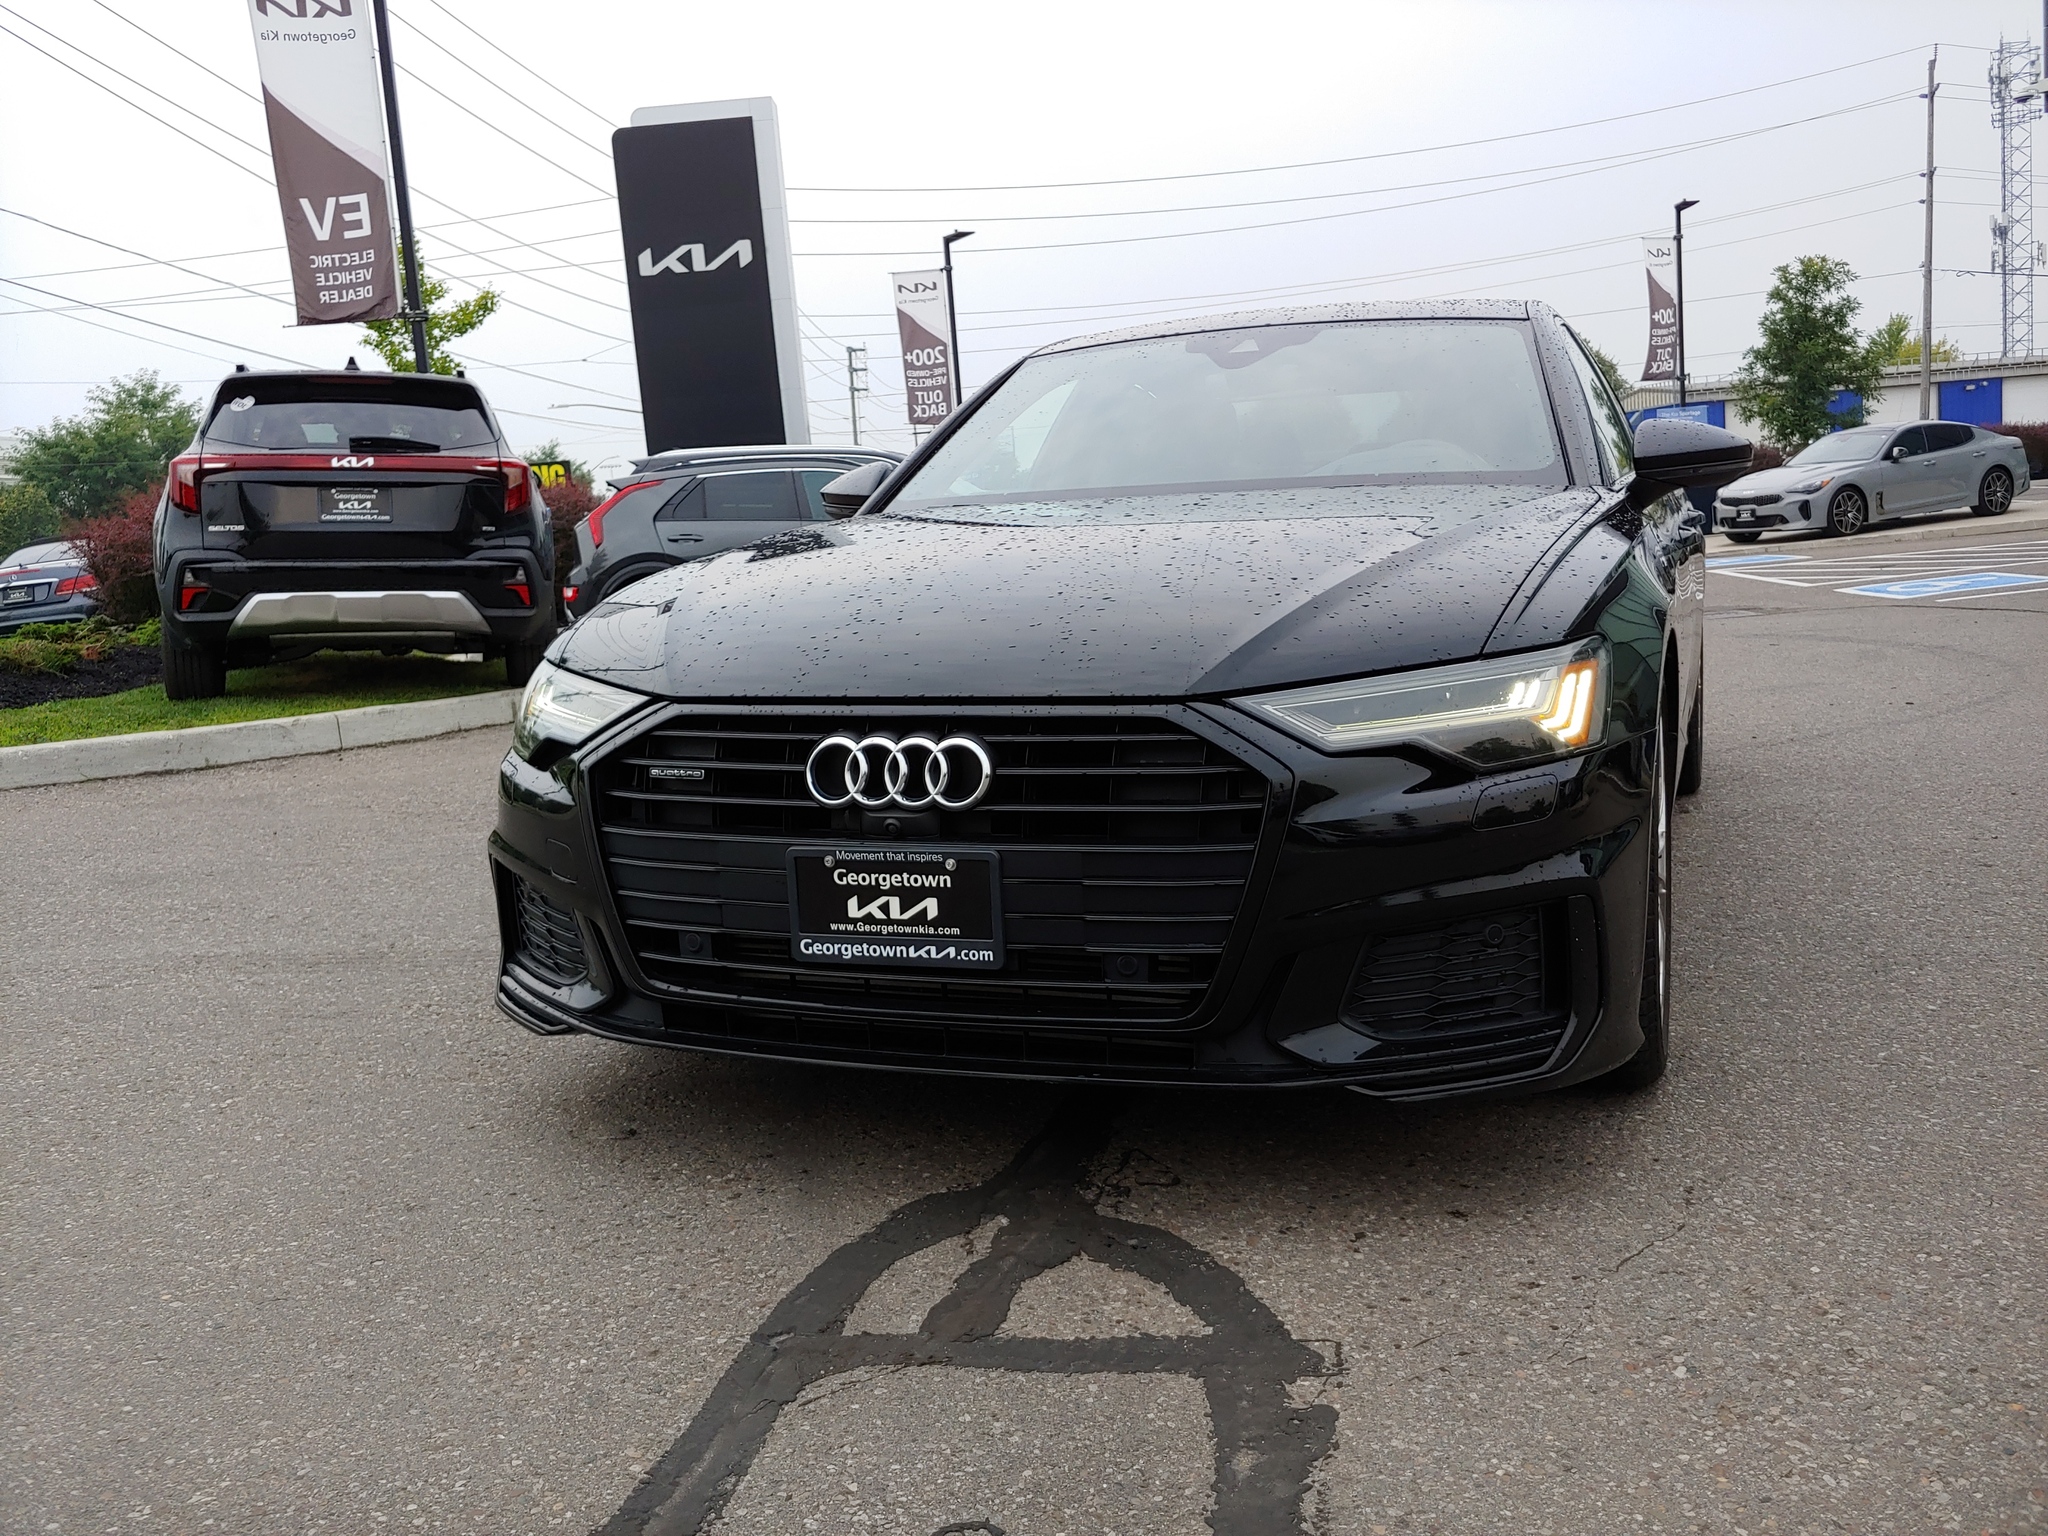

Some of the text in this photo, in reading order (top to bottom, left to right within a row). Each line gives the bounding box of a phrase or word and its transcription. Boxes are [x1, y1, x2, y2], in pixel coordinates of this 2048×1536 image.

[638, 239, 753, 276] KIA
[331, 456, 375, 468] KIA
[333, 492, 377, 500] Georgetown
[338, 501, 372, 509] KIA
[651, 769, 702, 777] quattro
[836, 850, 943, 863] Movement that inspires
[833, 868, 951, 890] Georgetown
[847, 894, 939, 921] KIA
[830, 922, 960, 935] www.Georgetownkia.com
